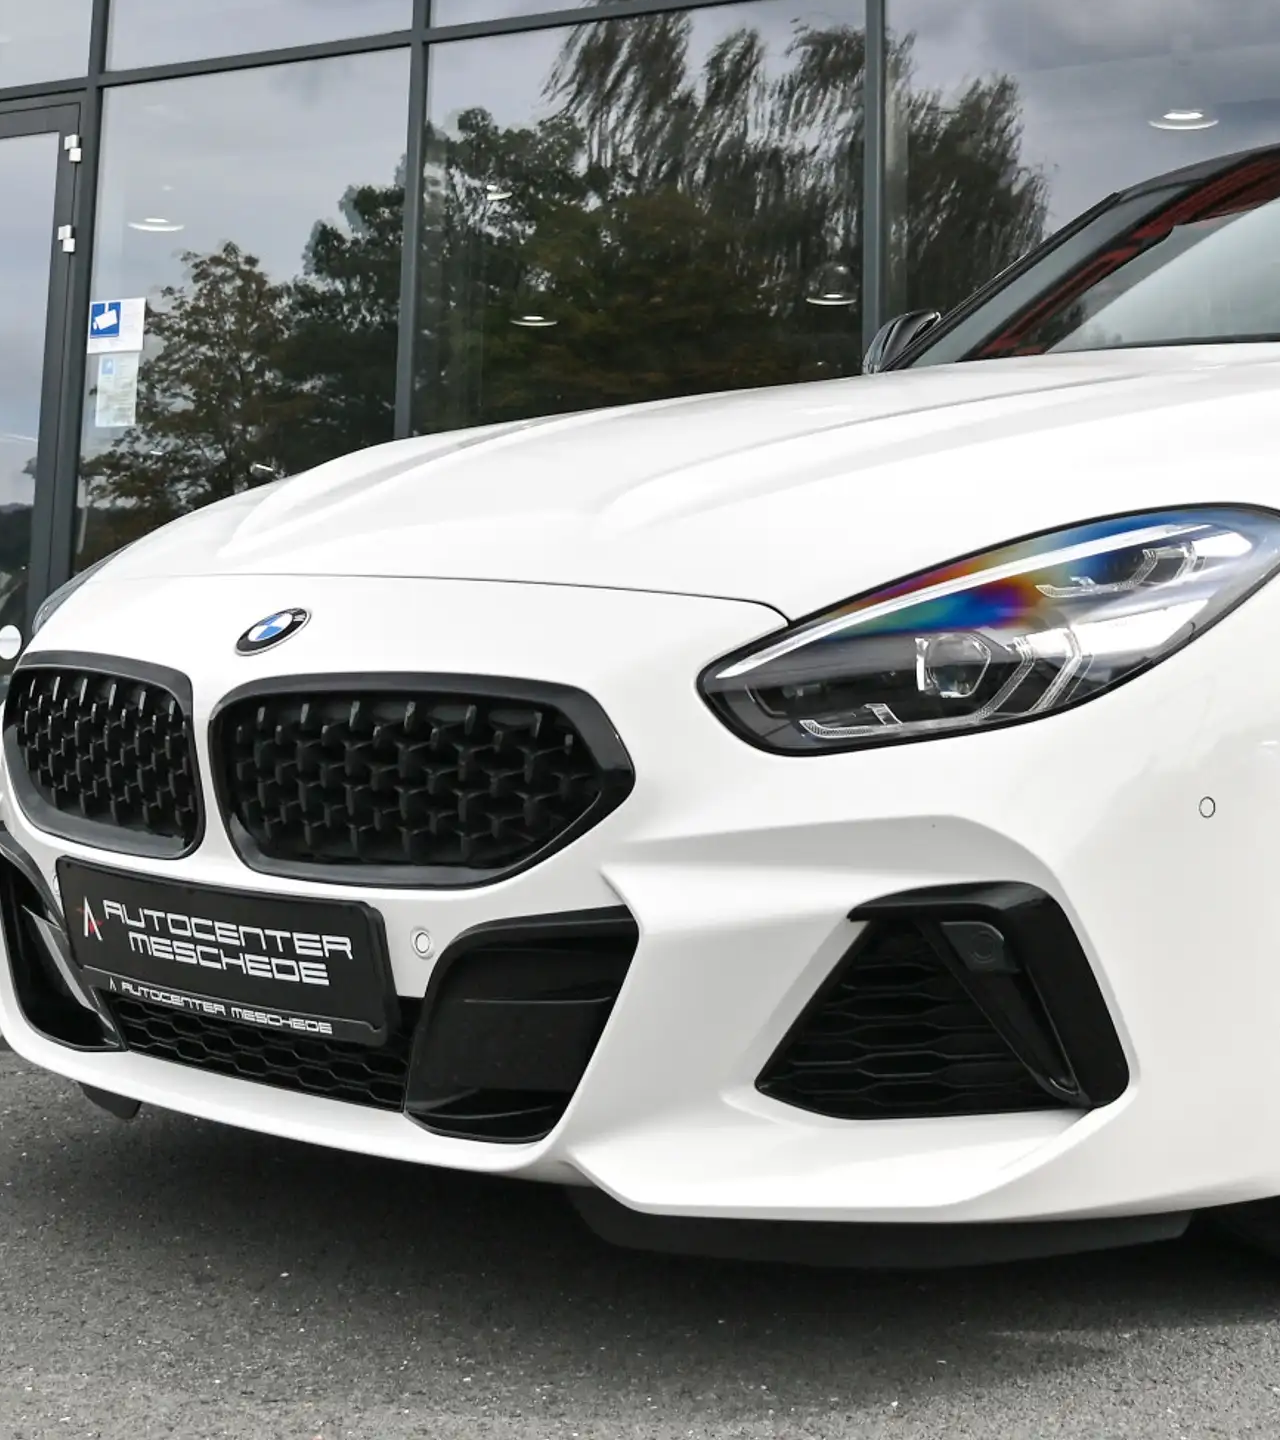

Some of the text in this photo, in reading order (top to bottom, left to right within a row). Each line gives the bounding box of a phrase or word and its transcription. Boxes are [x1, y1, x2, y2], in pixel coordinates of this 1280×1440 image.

[103, 899, 353, 960] AUTOCENTER
[128, 931, 330, 986] MESCHEDE
[121, 981, 226, 1016] AUTOCENTER
[230, 1007, 333, 1035] MESCHEDE
